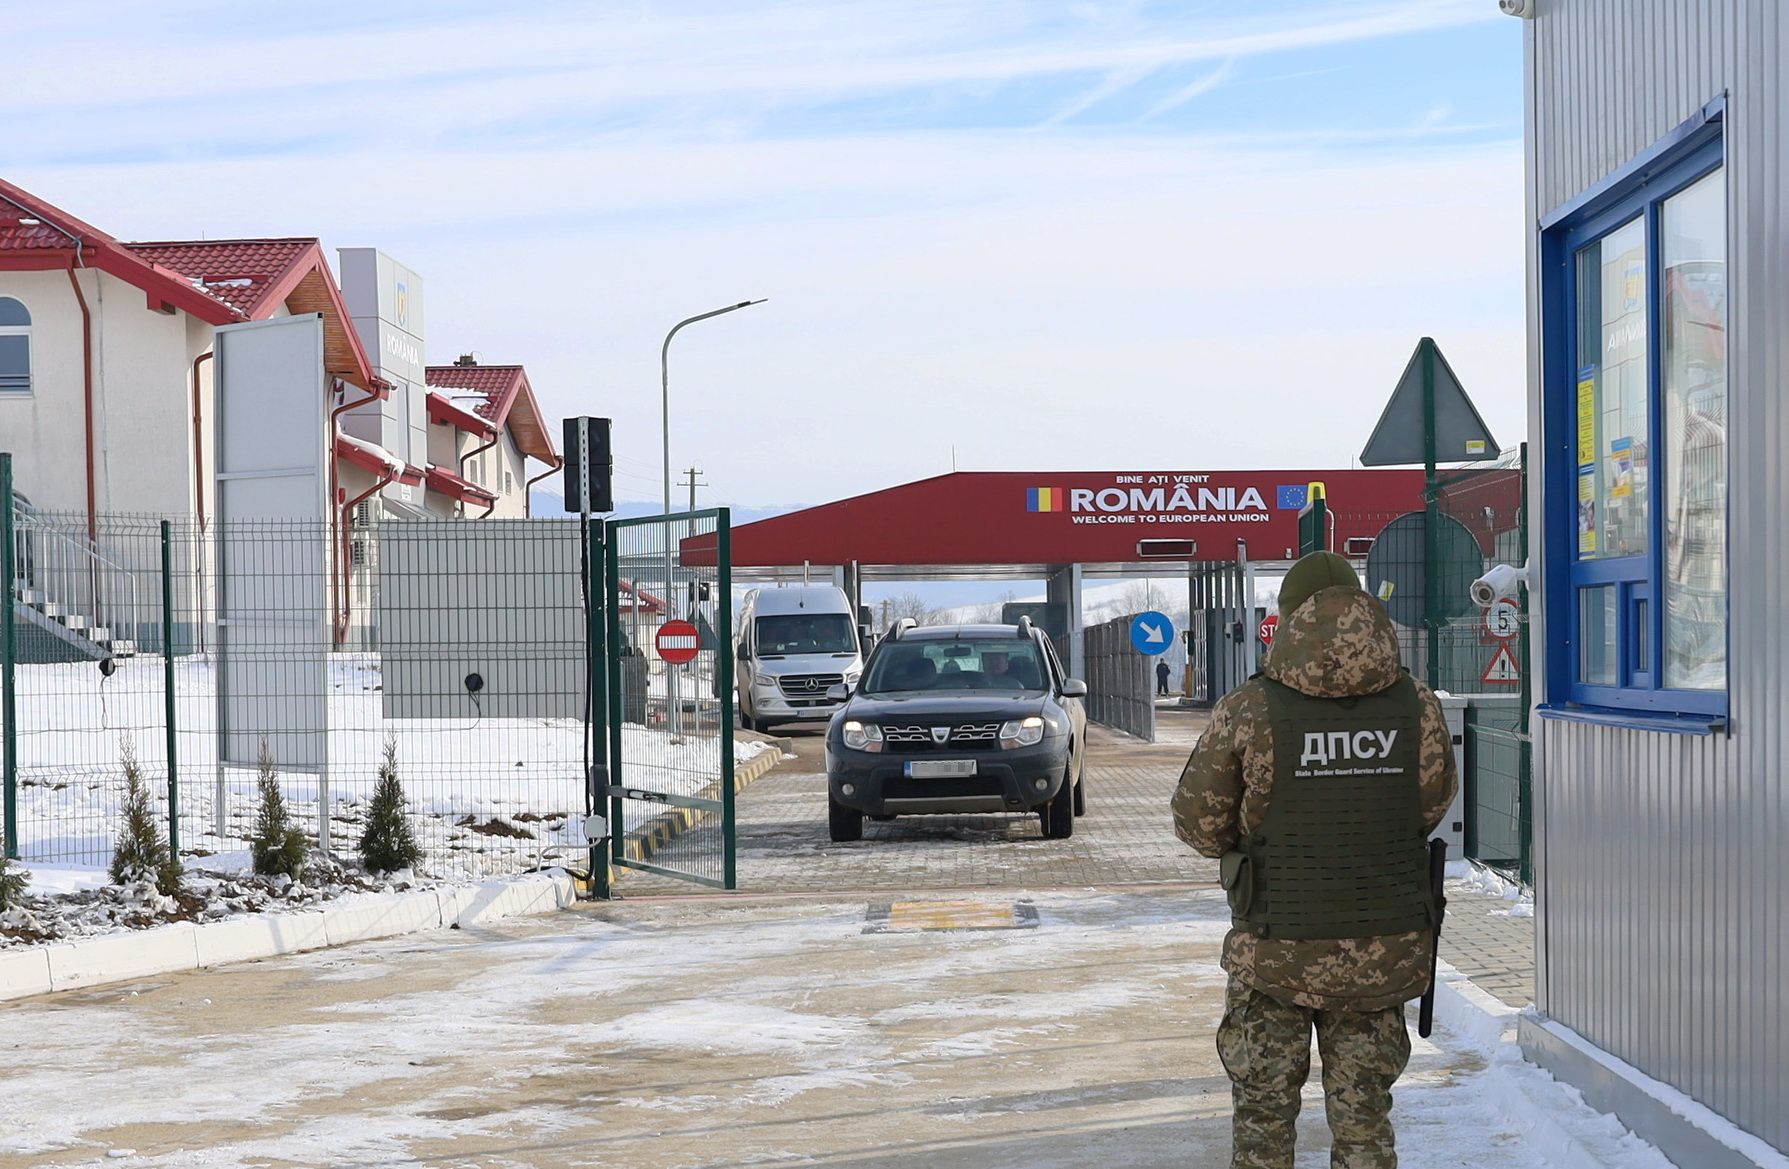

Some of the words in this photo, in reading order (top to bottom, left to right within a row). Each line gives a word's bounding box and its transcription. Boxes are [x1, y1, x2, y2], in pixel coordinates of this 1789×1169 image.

[1116, 475, 1143, 484] BINE
[1173, 475, 1210, 483] VENIT
[1070, 483, 1267, 512] ROMÂNIA
[1072, 515, 1136, 524] WELCOME
[1139, 515, 1156, 523] TO
[1159, 514, 1226, 523] EUROPEAN
[1229, 514, 1269, 522] UNION
[1498, 610, 1507, 629] 5
[1261, 624, 1278, 638] ST
[1300, 729, 1398, 767] ДПСУ
